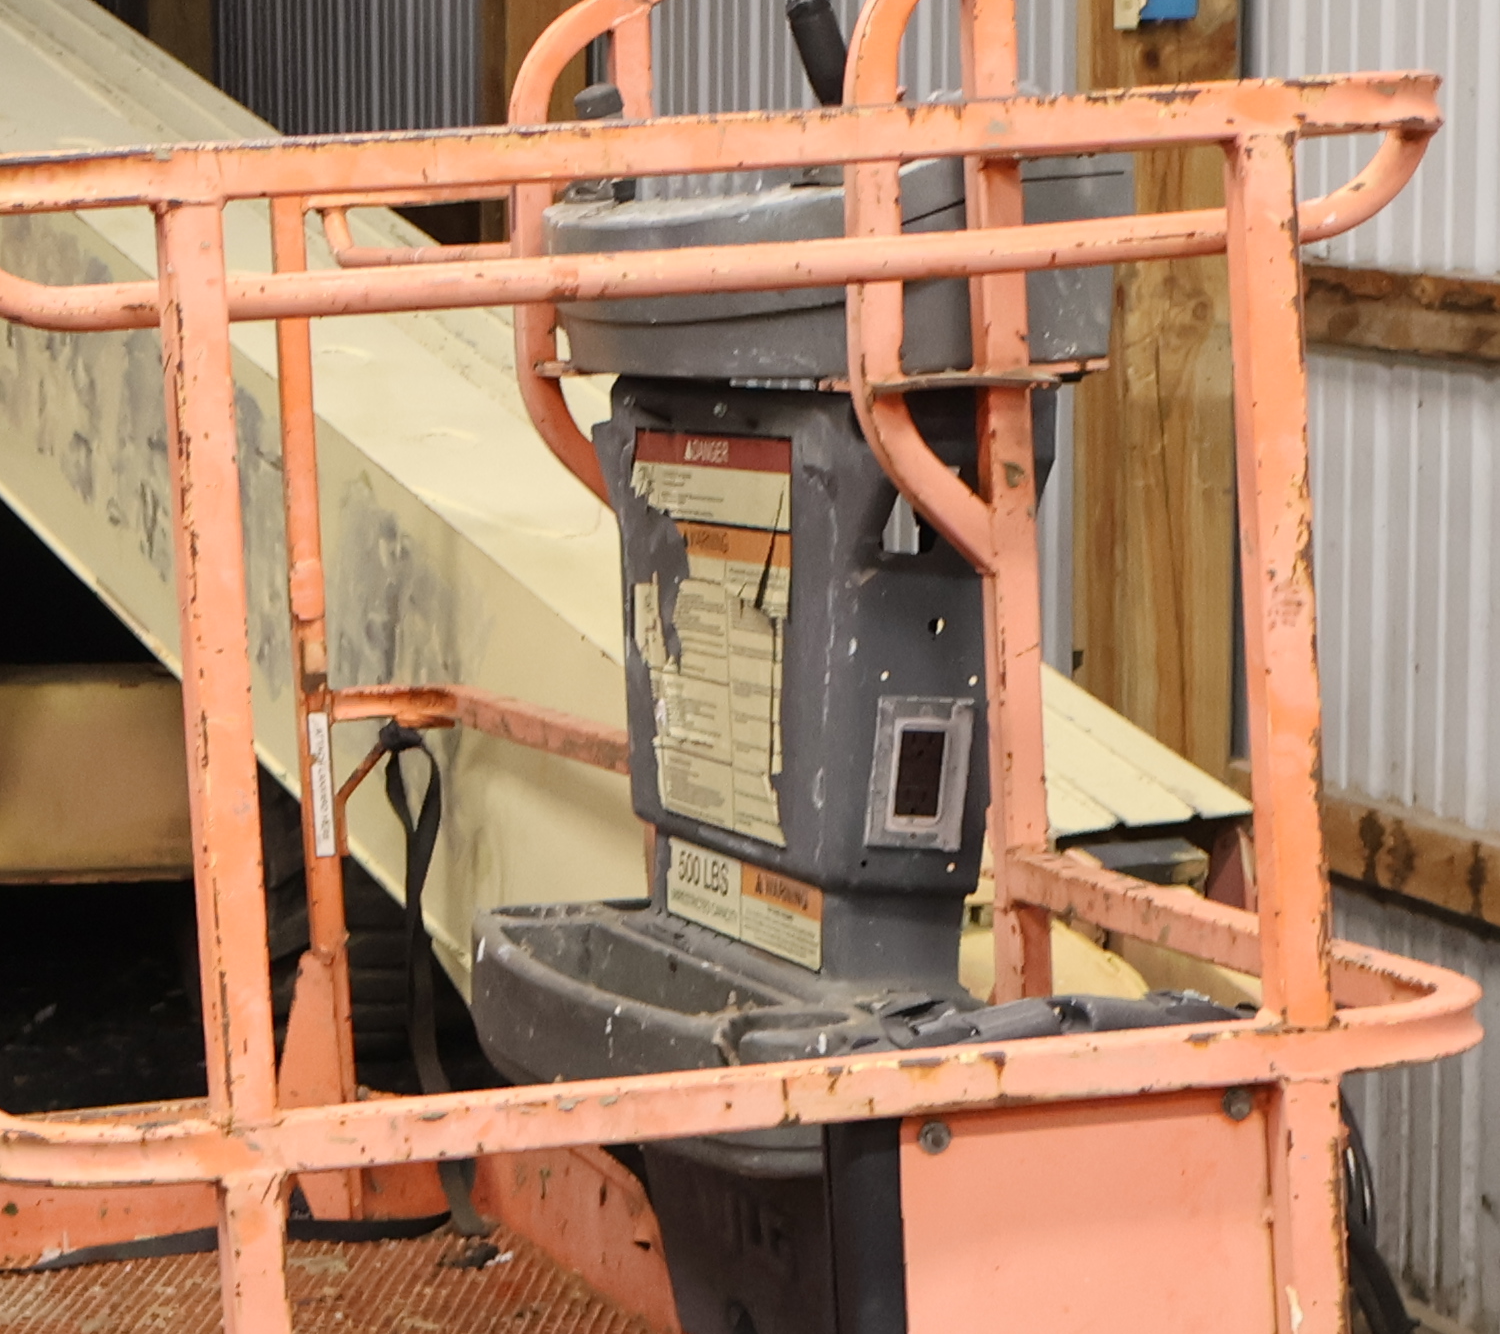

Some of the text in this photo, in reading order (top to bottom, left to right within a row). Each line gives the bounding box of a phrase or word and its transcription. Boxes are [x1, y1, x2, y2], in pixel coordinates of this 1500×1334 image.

[691, 439, 729, 464] DANGER
[317, 768, 328, 812] LANYARD
[321, 815, 330, 840] HERE
[678, 850, 730, 898] 500 LBS
[763, 873, 808, 911] WARNING
